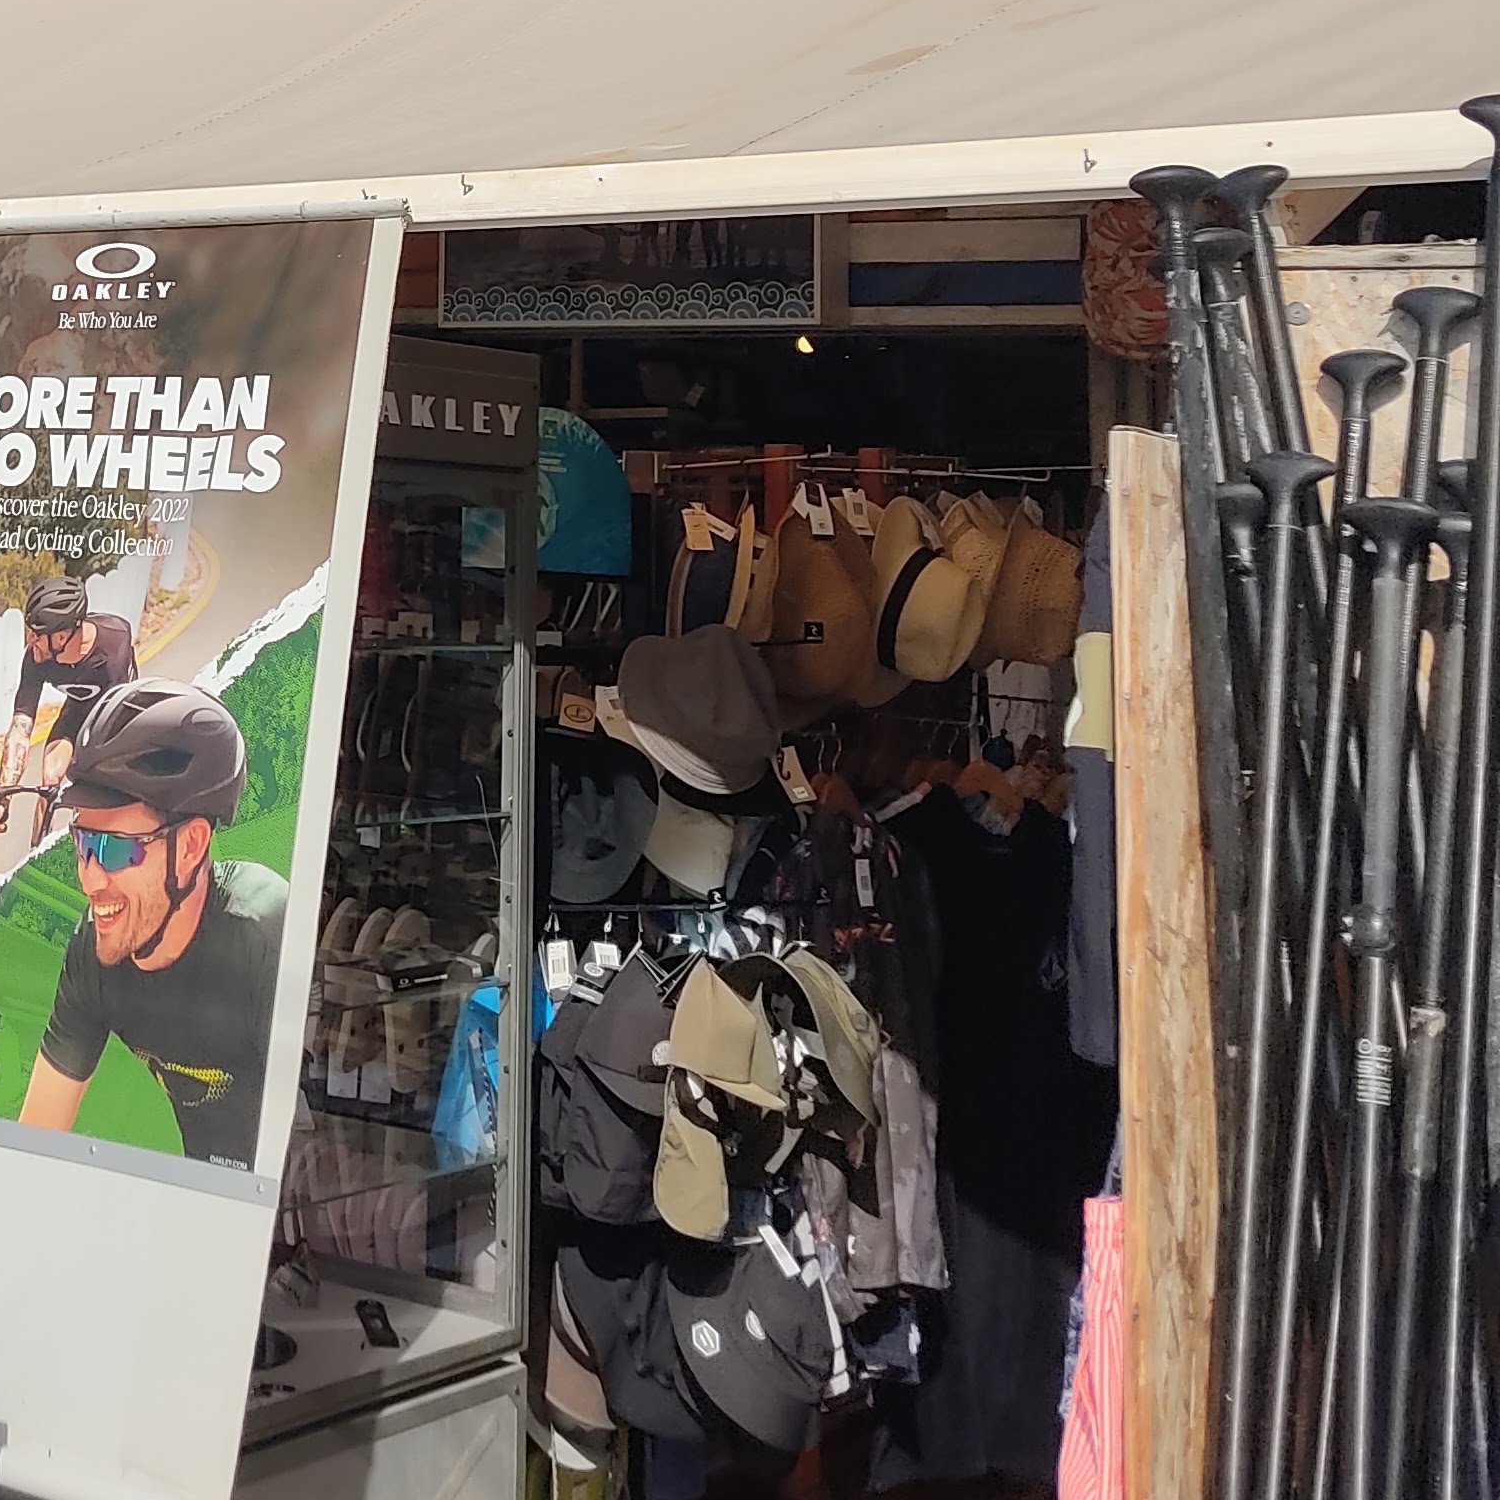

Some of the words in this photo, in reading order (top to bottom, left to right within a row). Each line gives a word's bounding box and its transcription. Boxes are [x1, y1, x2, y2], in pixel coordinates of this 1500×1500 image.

[51, 281, 173, 301] OAKLEY
[58, 312, 76, 329] Be
[78, 311, 107, 329] Who
[108, 311, 133, 329] You
[133, 311, 158, 329] Are
[105, 375, 271, 432] THAN
[49, 433, 287, 493] WHEELS
[51, 493, 82, 519] the
[82, 494, 148, 529] Oakley
[150, 497, 190, 523] 2022
[25, 526, 85, 558] Cycling
[88, 529, 174, 557] Collection
